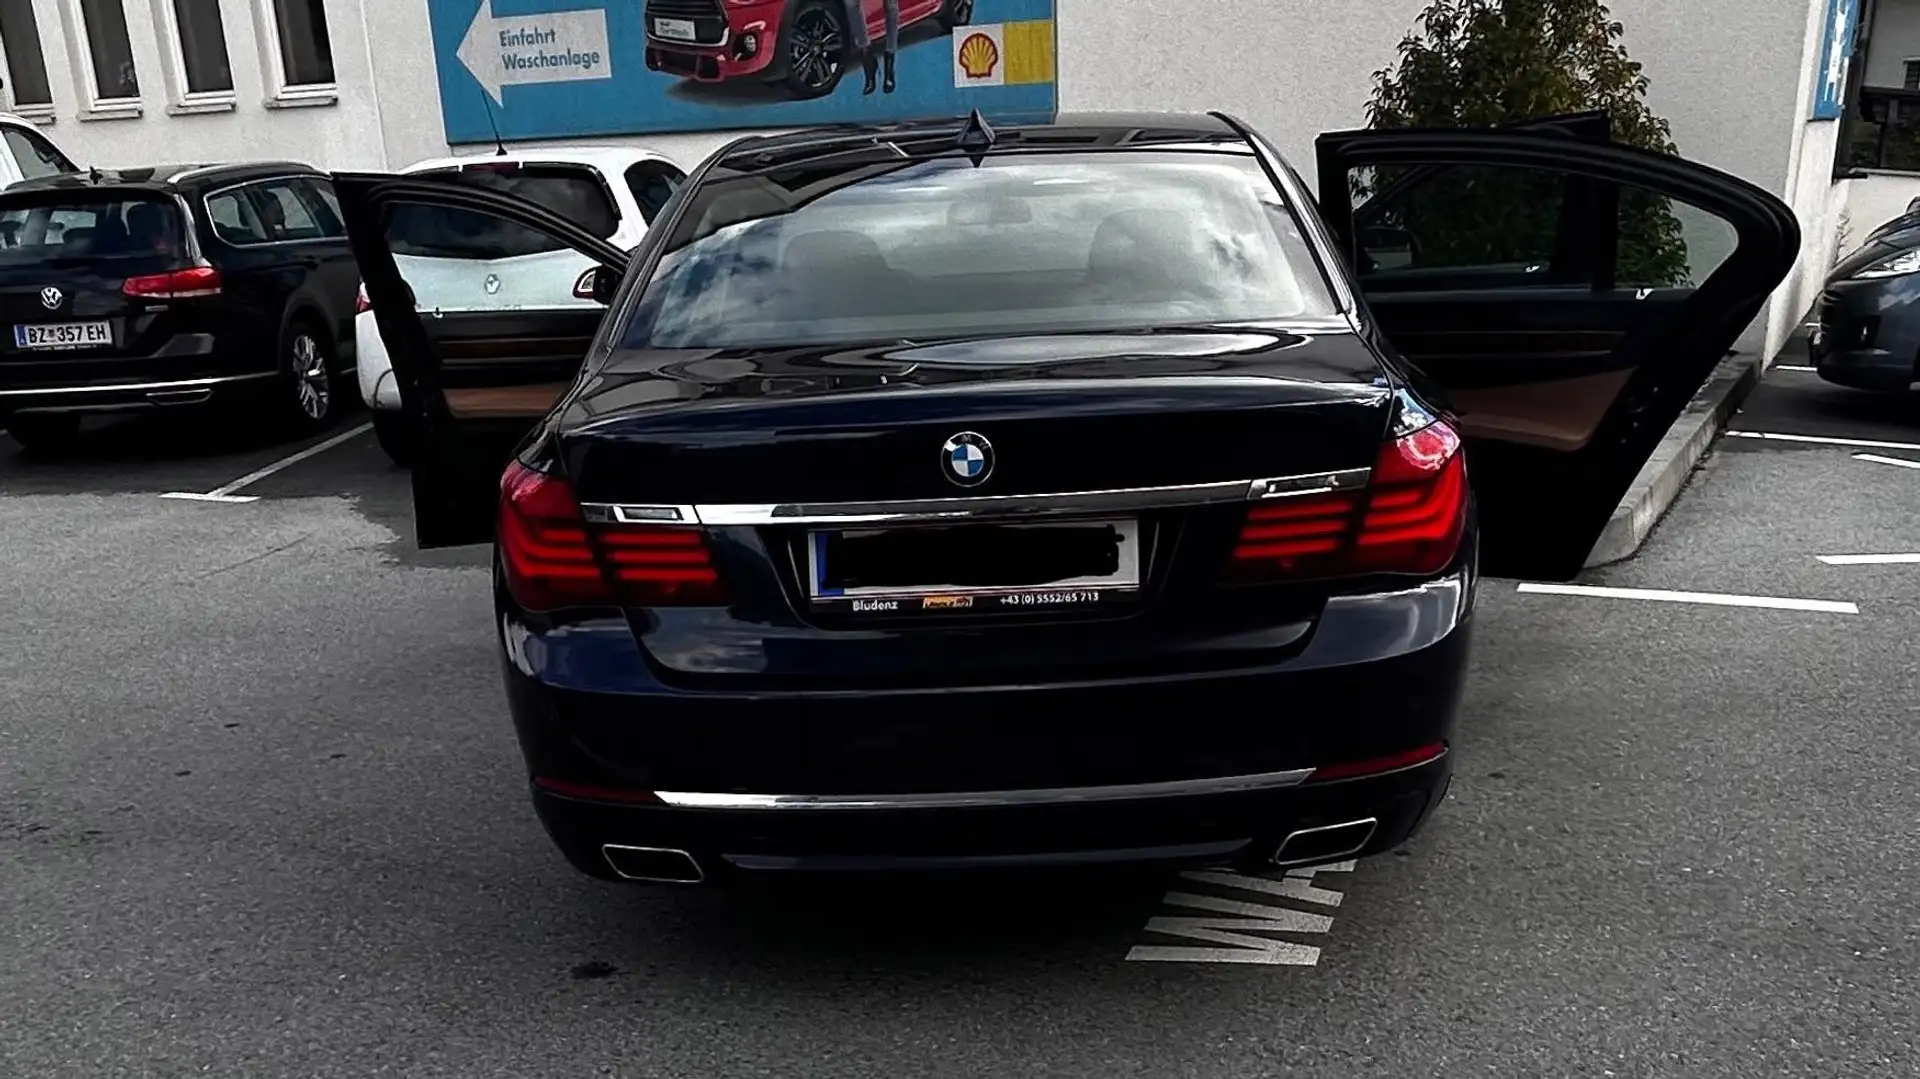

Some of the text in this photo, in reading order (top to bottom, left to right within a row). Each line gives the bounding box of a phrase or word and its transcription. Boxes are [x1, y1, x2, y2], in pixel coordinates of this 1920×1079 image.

[499, 26, 556, 47] Einfahrt
[502, 48, 600, 70] Waschanlage
[28, 324, 106, 343] BZ 357 EH
[853, 598, 898, 611] Bludenz
[1000, 595, 1020, 605] +43
